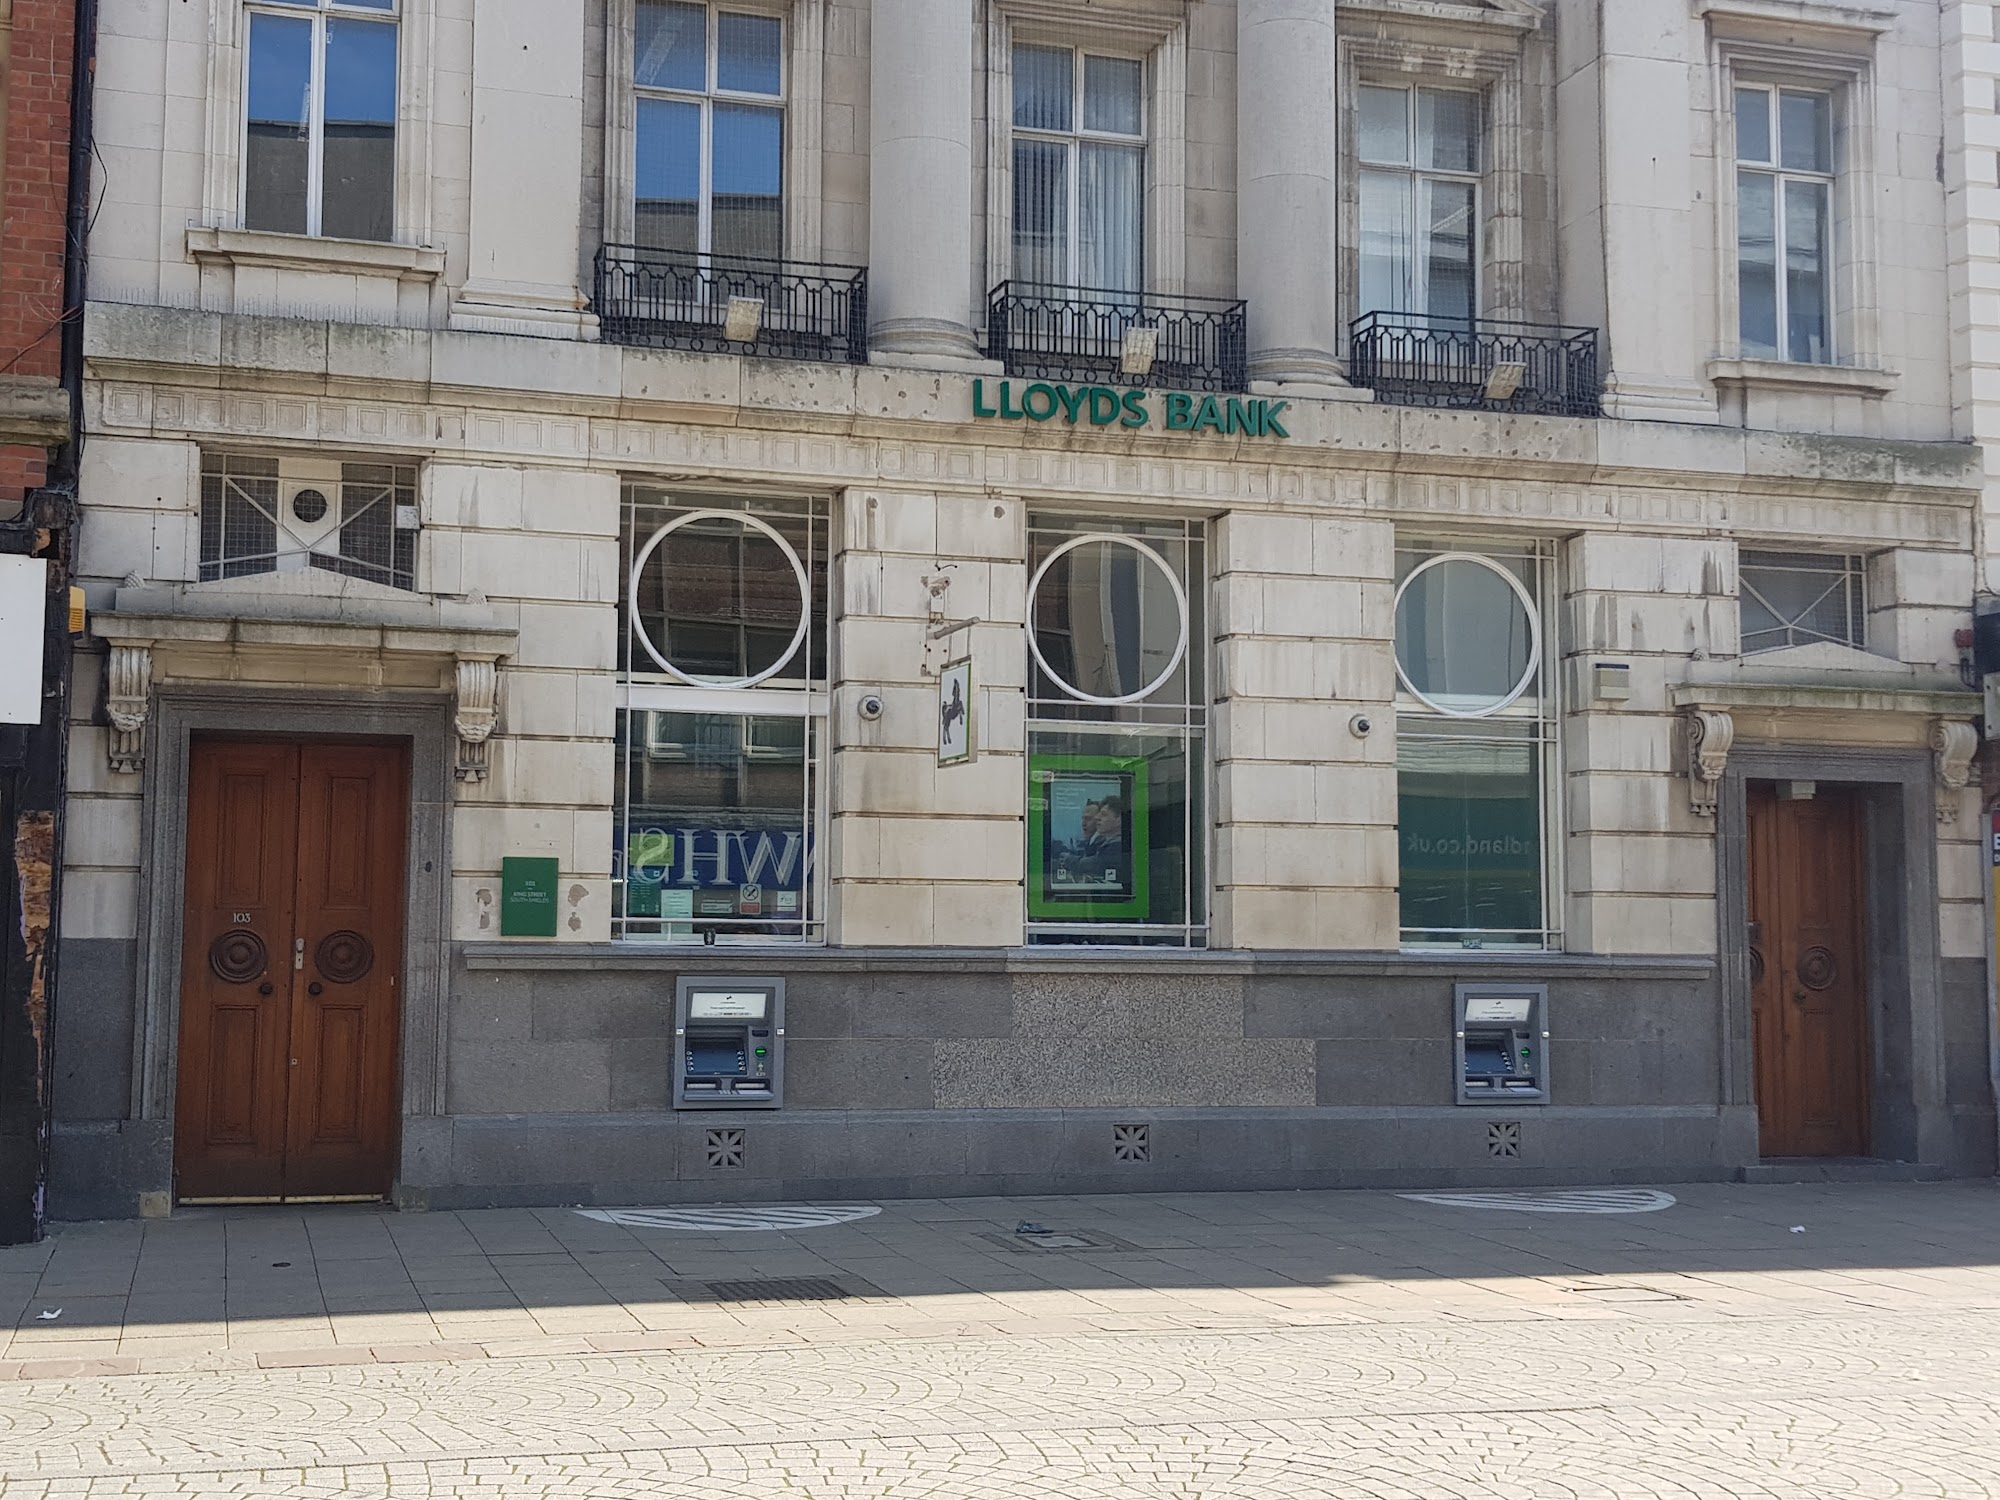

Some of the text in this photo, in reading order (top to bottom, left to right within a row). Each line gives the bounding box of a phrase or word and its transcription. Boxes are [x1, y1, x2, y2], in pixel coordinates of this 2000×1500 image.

[973, 379, 1290, 438] LLOYDS BANK
[233, 912, 251, 923] 103
